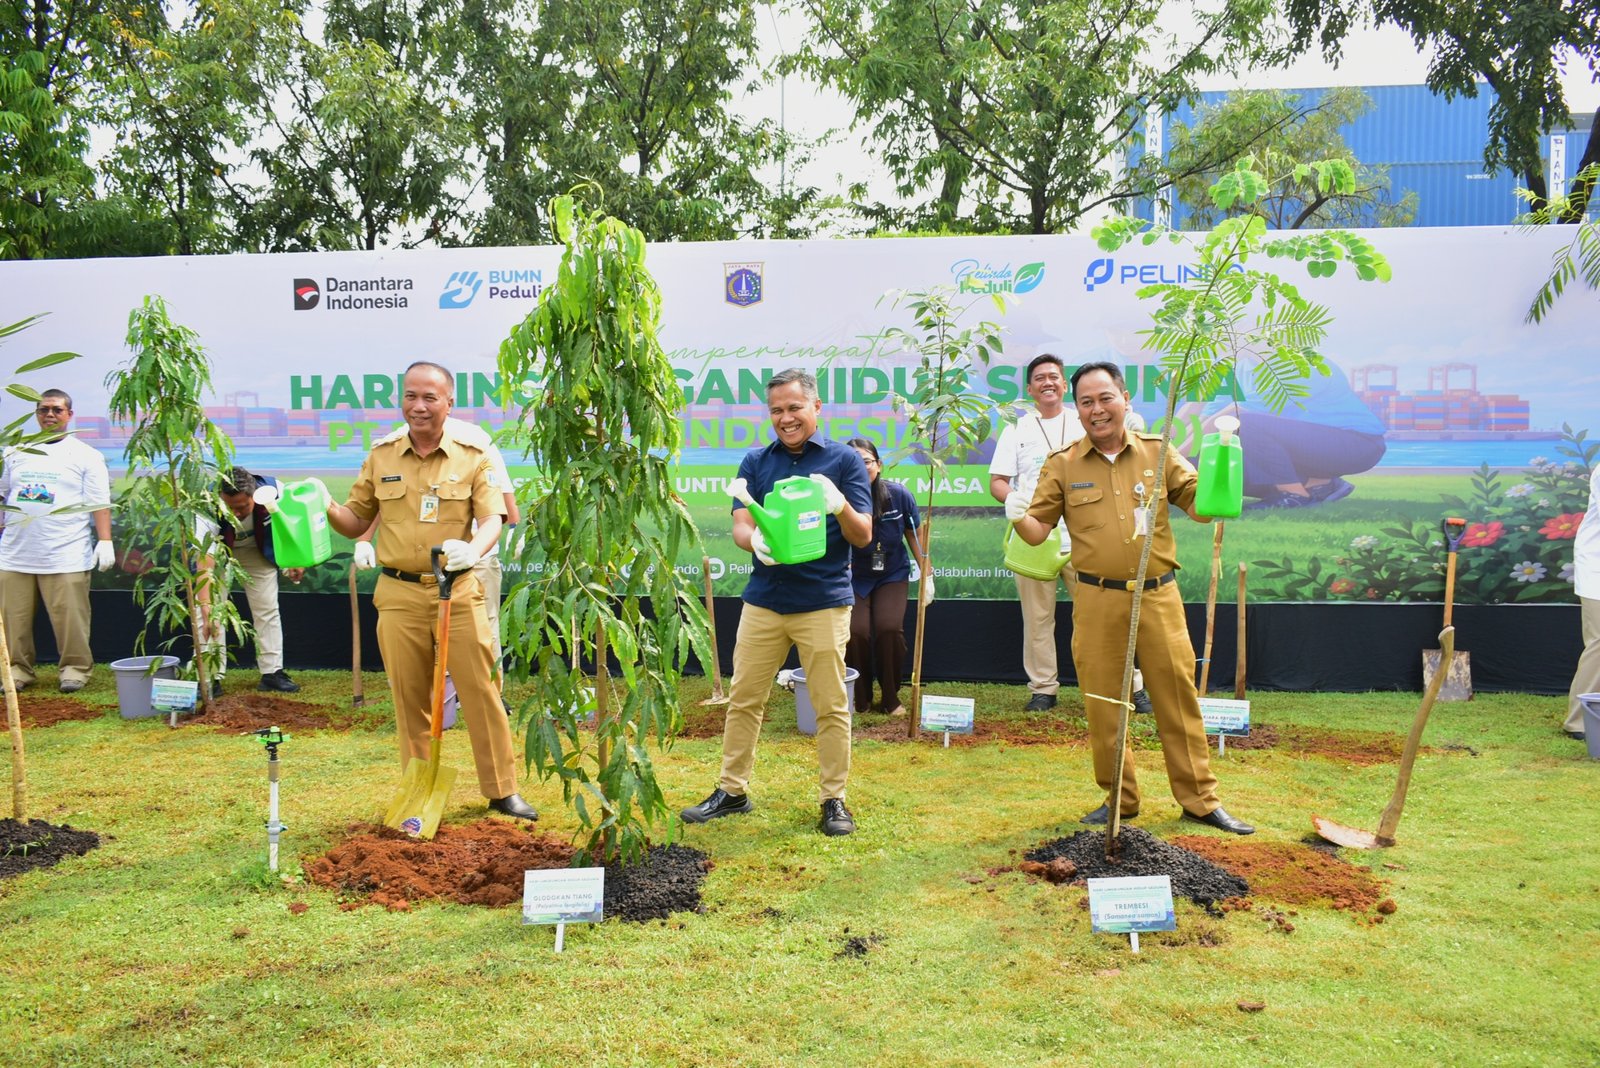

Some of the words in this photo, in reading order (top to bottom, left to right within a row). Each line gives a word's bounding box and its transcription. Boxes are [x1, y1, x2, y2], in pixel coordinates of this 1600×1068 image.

[326, 277, 414, 293] Danantara
[488, 270, 542, 284] BUMN
[488, 285, 542, 299] Peduli
[326, 294, 409, 310] Indonesia
[328, 421, 381, 452] PT
[676, 477, 737, 494] UNTU
[916, 477, 985, 494] MASA
[994, 566, 1014, 578] Ind
[1114, 902, 1149, 910] TREMBESI
